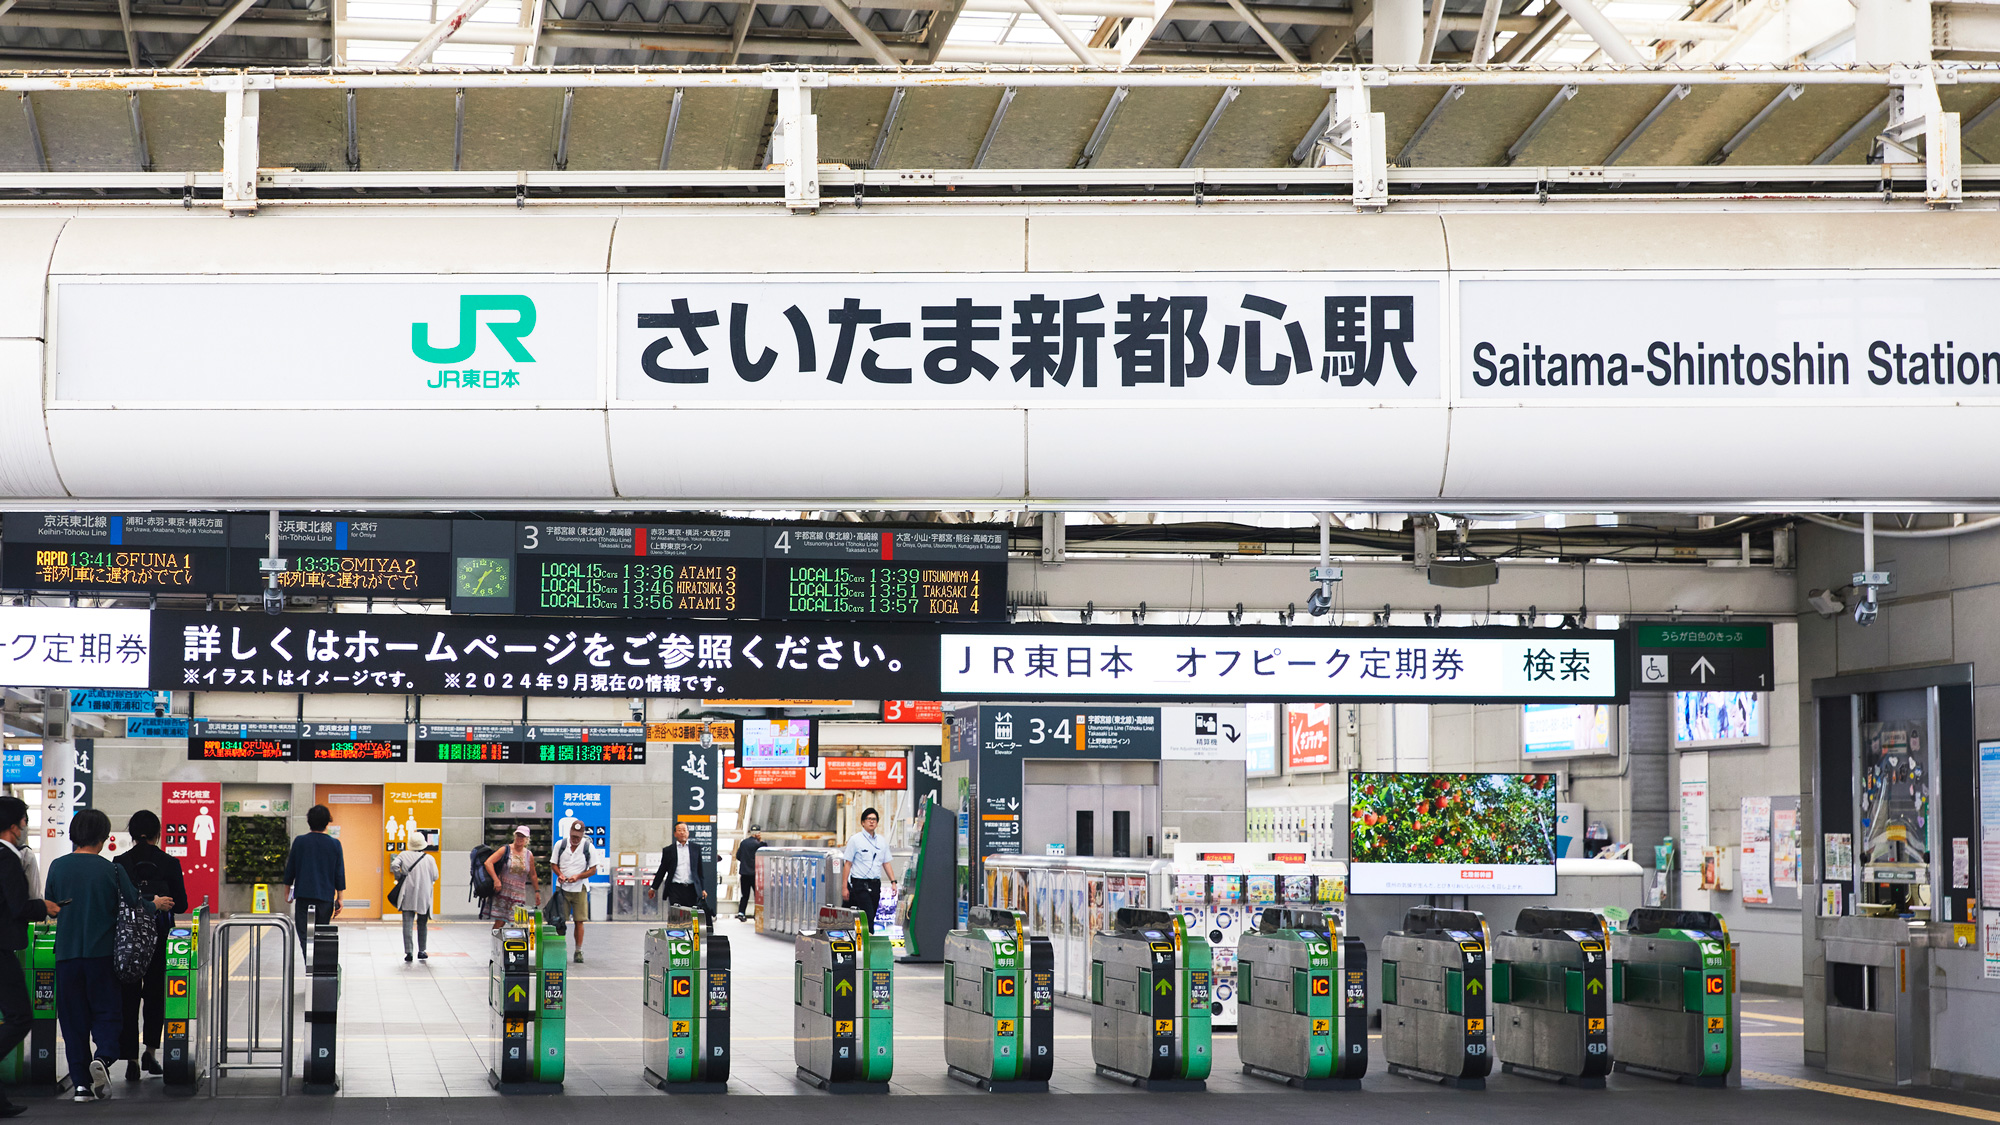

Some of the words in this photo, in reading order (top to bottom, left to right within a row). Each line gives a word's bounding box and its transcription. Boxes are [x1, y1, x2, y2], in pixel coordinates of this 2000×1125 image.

[412, 295, 536, 363] JR
[637, 293, 1417, 387] さいたま新都心駅
[1472, 341, 1849, 387] Saitama-Shintoshin
[1868, 340, 2000, 386] Station
[427, 369, 520, 389] JR東日本
[44, 515, 107, 527] 京浜東北線
[126, 516, 223, 528] 浦和・赤羽・東京・横浜方面
[351, 521, 377, 531] 大宮行
[38, 528, 90, 537] Keihin-Tōhoku
[91, 529, 107, 537] Line
[265, 533, 316, 542] Khin-Tōhoku
[318, 534, 333, 542] Line
[523, 526, 539, 549] 3
[896, 533, 1002, 544] 大宮・小山・宇都宮・熊谷・高崎方面
[774, 530, 791, 554] 4
[36, 551, 68, 566] RAPID
[70, 551, 112, 567] 13:41
[183, 553, 191, 569] 1
[296, 557, 340, 572] 13:35
[405, 559, 415, 573] 2
[541, 563, 586, 578] LOCAL
[623, 564, 674, 579] 13:36
[679, 566, 722, 580] ATAMI
[726, 566, 736, 580] 3
[790, 568, 833, 582] LOCAL
[869, 569, 920, 583] 13:39
[922, 570, 969, 583] UTSUNOMIYA
[970, 570, 980, 584] 4
[541, 578, 586, 593] LOCAL
[623, 580, 674, 594] 13:46
[676, 581, 723, 594] HIRATSUKA
[726, 581, 736, 594] 3
[790, 583, 833, 597] LOCAL
[869, 584, 920, 598] 13:51
[922, 585, 967, 599] TAKASAKI
[970, 585, 980, 600] 4
[541, 593, 586, 608] LOCAL
[623, 594, 674, 609] 13:56
[678, 596, 721, 610] ATAMI
[726, 596, 736, 610] 3
[790, 597, 833, 612] LOCAL
[869, 599, 918, 613] 13:57
[930, 600, 959, 614] KOGA
[970, 600, 980, 615] 4
[1661, 631, 1743, 642] うらが白色のきっぷ
[0, 632, 147, 664] ク定期券
[183, 624, 903, 672] 詳しくはホームページをご参照ください。
[959, 643, 1134, 679] JR東日本
[1177, 646, 1464, 680] オフピーク定期券
[1522, 647, 1591, 682] 検索
[183, 668, 415, 690] ※イラストはイメージです。
[444, 672, 725, 694] ※2024年9月現在の情報です。
[1758, 674, 1765, 686] 1
[887, 701, 902, 720] 3
[193, 723, 199, 735] 1
[302, 724, 311, 737] 2
[418, 725, 428, 738] 3
[526, 727, 536, 740] 4
[220, 741, 242, 749] 13:41
[331, 742, 353, 751] 13:35
[385, 743, 391, 751] 2
[727, 761, 741, 782] 3
[887, 761, 904, 784] 4
[73, 781, 87, 807] 2
[172, 790, 211, 799] 女子化粧室
[389, 791, 437, 799] ファミリー化粧室
[564, 792, 601, 801] 男子化粧室
[689, 786, 705, 811] 3
[1011, 821, 1019, 834] 3
[168, 941, 189, 954] IC
[671, 942, 691, 955] IC
[995, 942, 1015, 955] IC
[1309, 942, 1329, 955] IC
[1701, 942, 1722, 954] IC
[672, 958, 690, 967] 専用
[998, 958, 1014, 967] 専用
[1312, 958, 1329, 966] 専用
[1707, 957, 1722, 966] 専用
[169, 980, 186, 996] IC
[673, 979, 690, 995] IC
[997, 979, 1014, 995] IC
[1313, 979, 1329, 995] IC
[1708, 978, 1722, 993] IC
